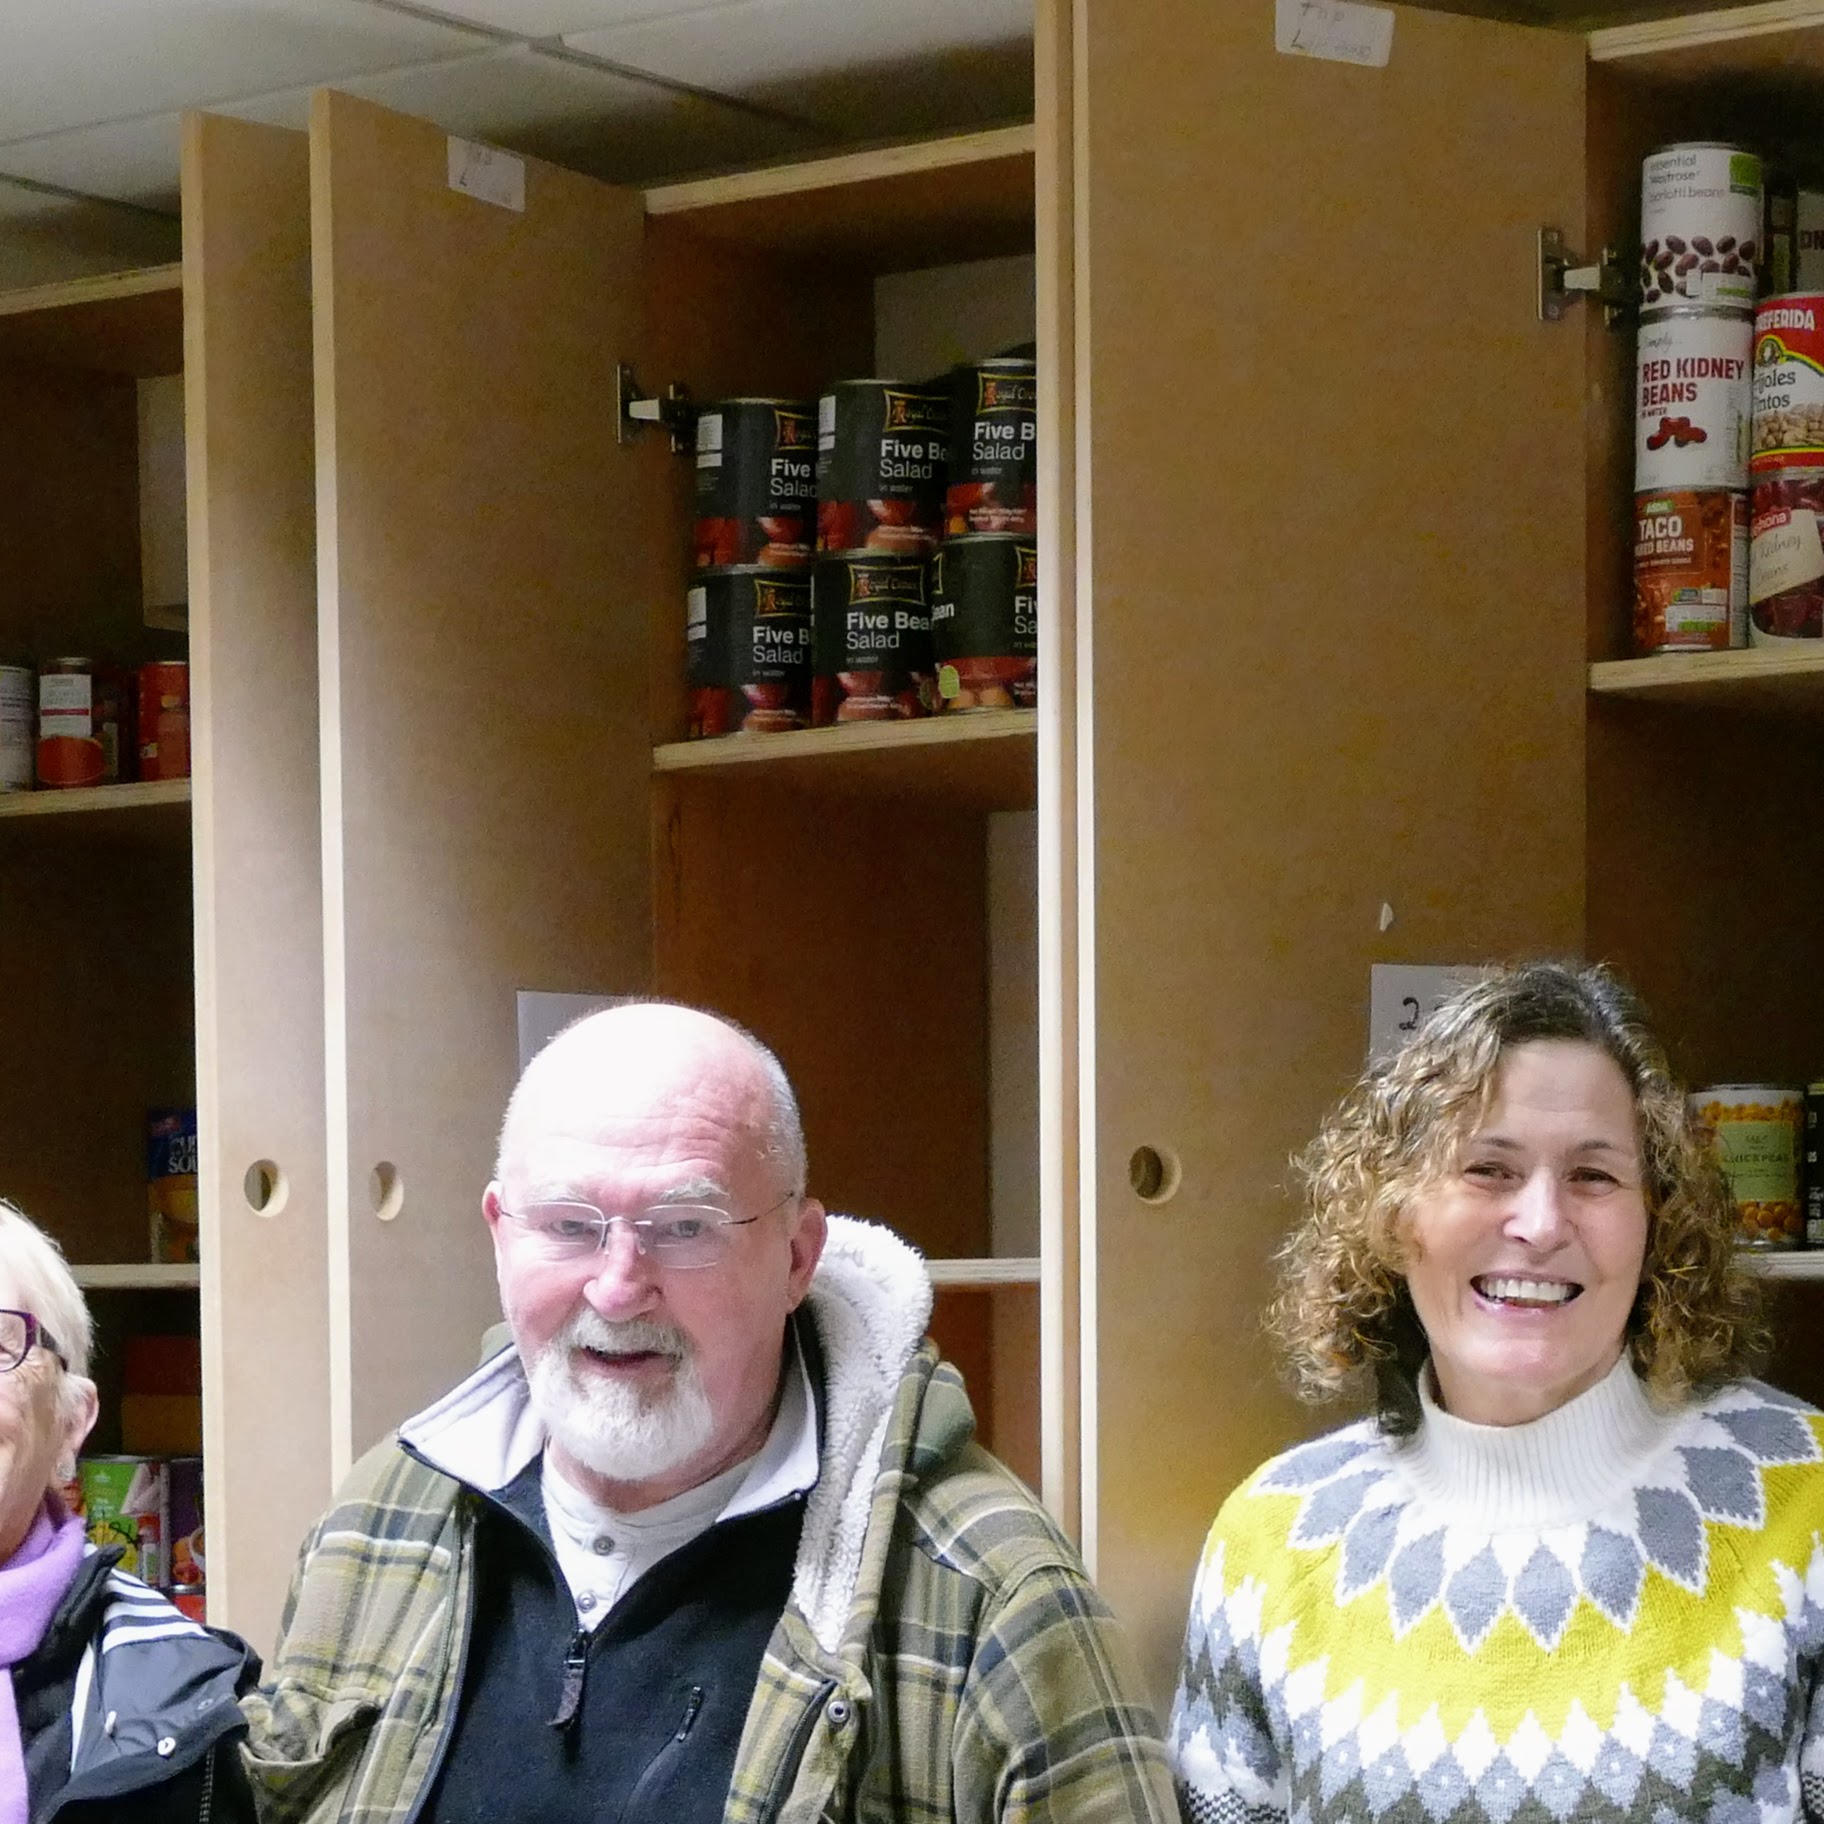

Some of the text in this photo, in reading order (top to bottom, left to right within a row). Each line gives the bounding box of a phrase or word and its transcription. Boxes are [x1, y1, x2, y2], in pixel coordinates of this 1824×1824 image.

[1642, 357, 1745, 383] RED KIDNEY
[1642, 382, 1698, 408] BEANS
[974, 422, 1036, 441] Five B
[880, 439, 946, 461] Five Be
[973, 441, 1025, 461] Salad
[771, 458, 811, 478] Five
[879, 460, 933, 480] Salad
[1638, 515, 1683, 540] TACO
[1656, 537, 1694, 553] BEANS
[846, 611, 932, 631] Five Bea
[1014, 616, 1037, 636] Sa
[752, 626, 811, 646] Five B
[846, 631, 900, 651] Salad
[752, 645, 804, 665] Salad
